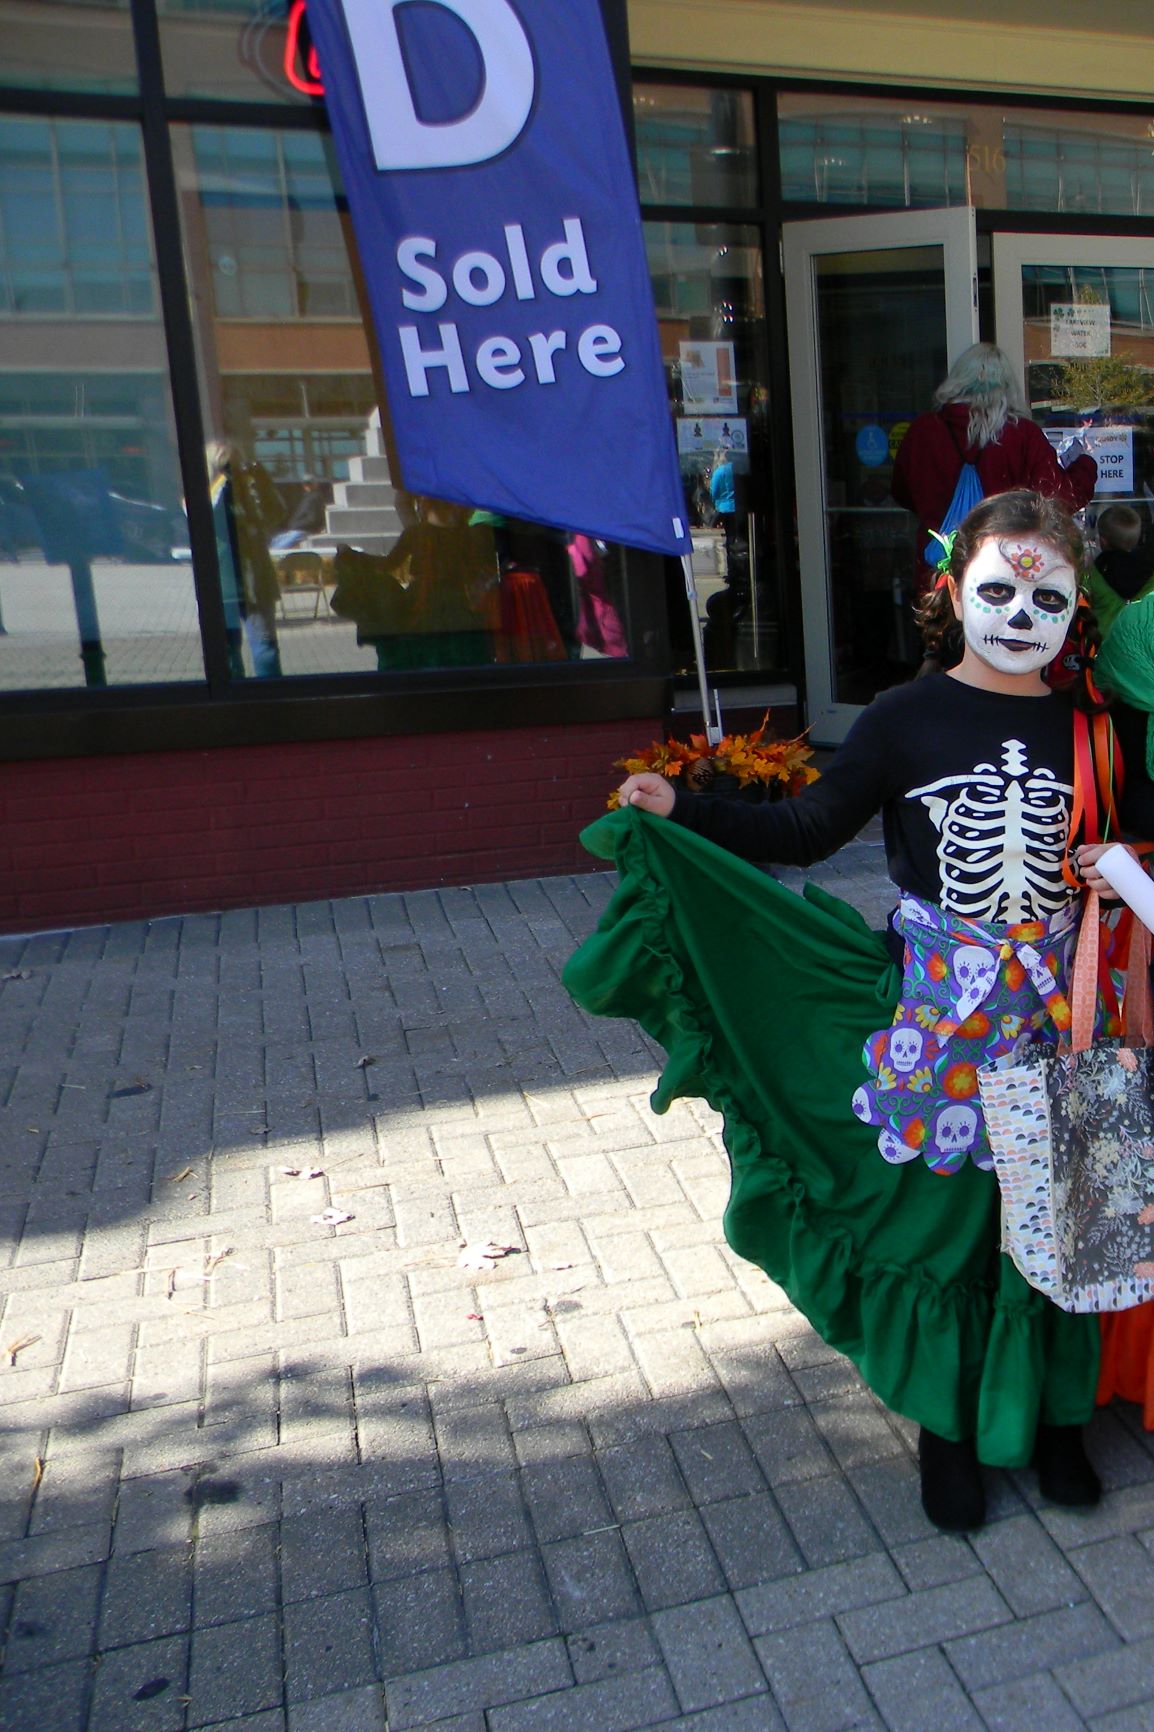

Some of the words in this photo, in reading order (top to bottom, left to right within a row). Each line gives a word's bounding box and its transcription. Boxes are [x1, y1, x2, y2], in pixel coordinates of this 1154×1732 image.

[341, 0, 535, 171] D
[396, 217, 598, 313] Sold
[398, 323, 626, 397] Here
[1099, 454, 1124, 464] STOP
[1100, 469, 1124, 479] HERE
